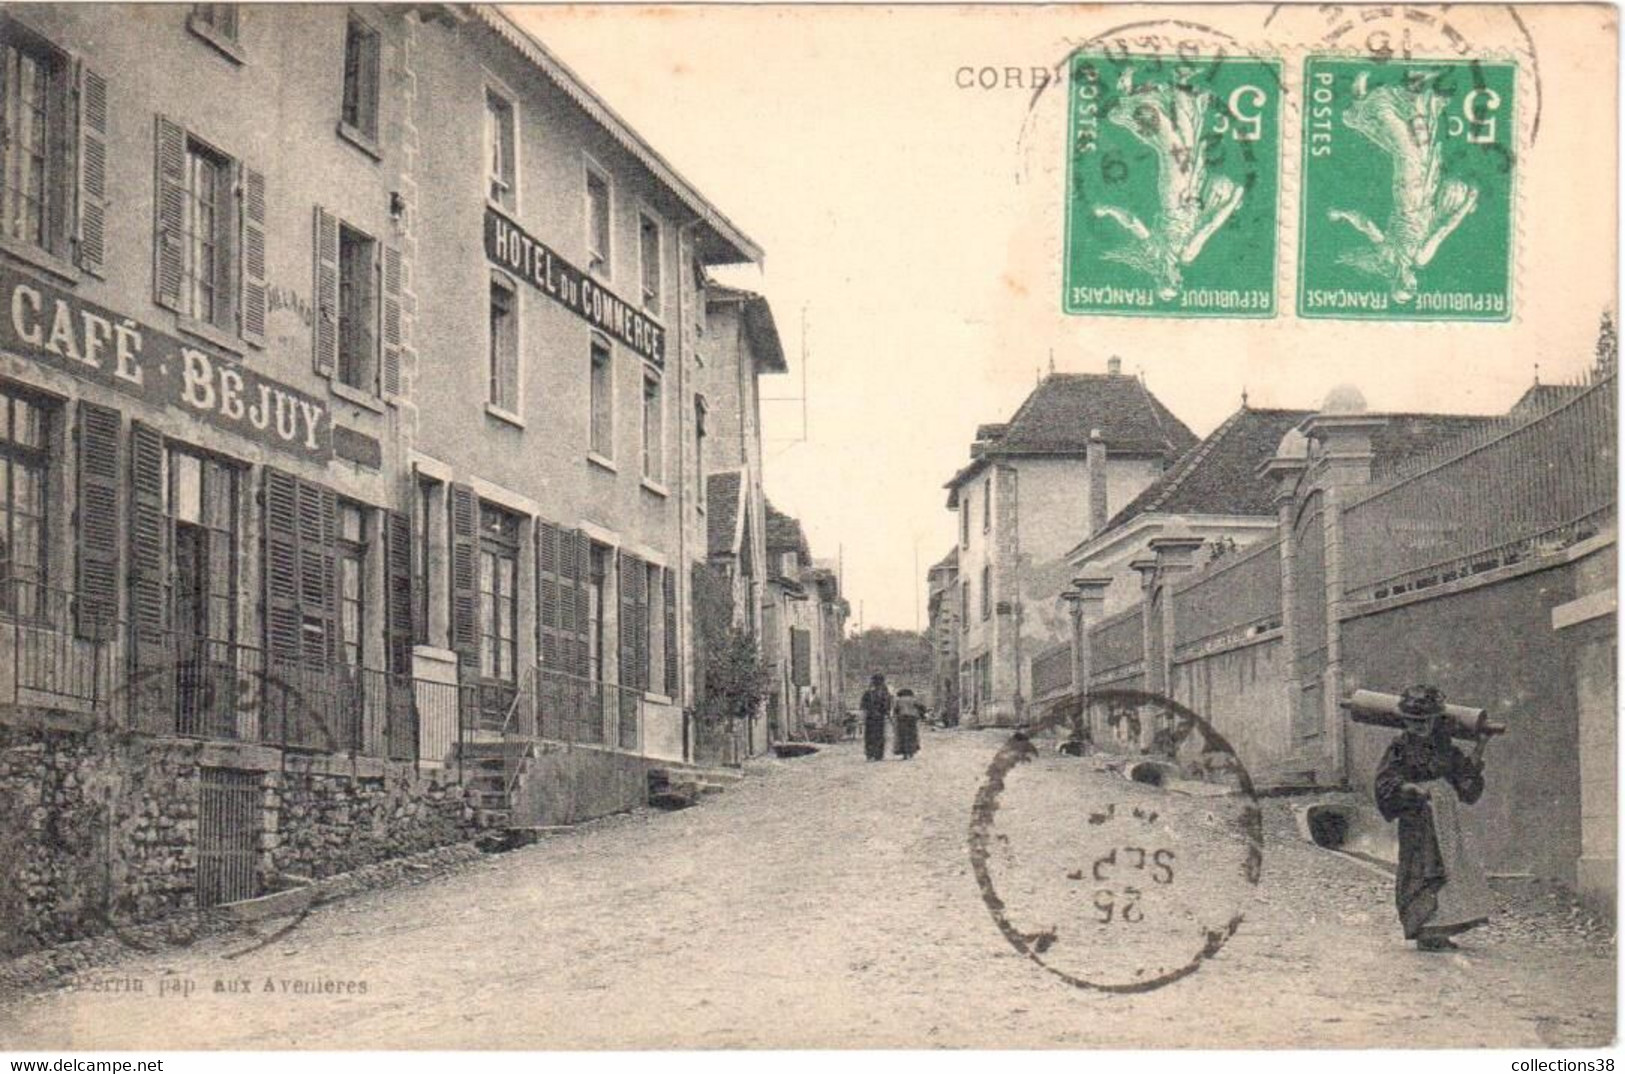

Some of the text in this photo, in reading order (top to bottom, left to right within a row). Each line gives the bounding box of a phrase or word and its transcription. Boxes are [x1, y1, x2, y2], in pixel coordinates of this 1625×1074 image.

[1312, 72, 1334, 157] POSTES
[496, 218, 661, 361] HOTEL DU COMMERCE
[1073, 286, 1153, 306] FRANÇAISE
[1307, 289, 1387, 310] FRANÇAISE
[11, 284, 323, 450] CAFÉ BÉJUY
